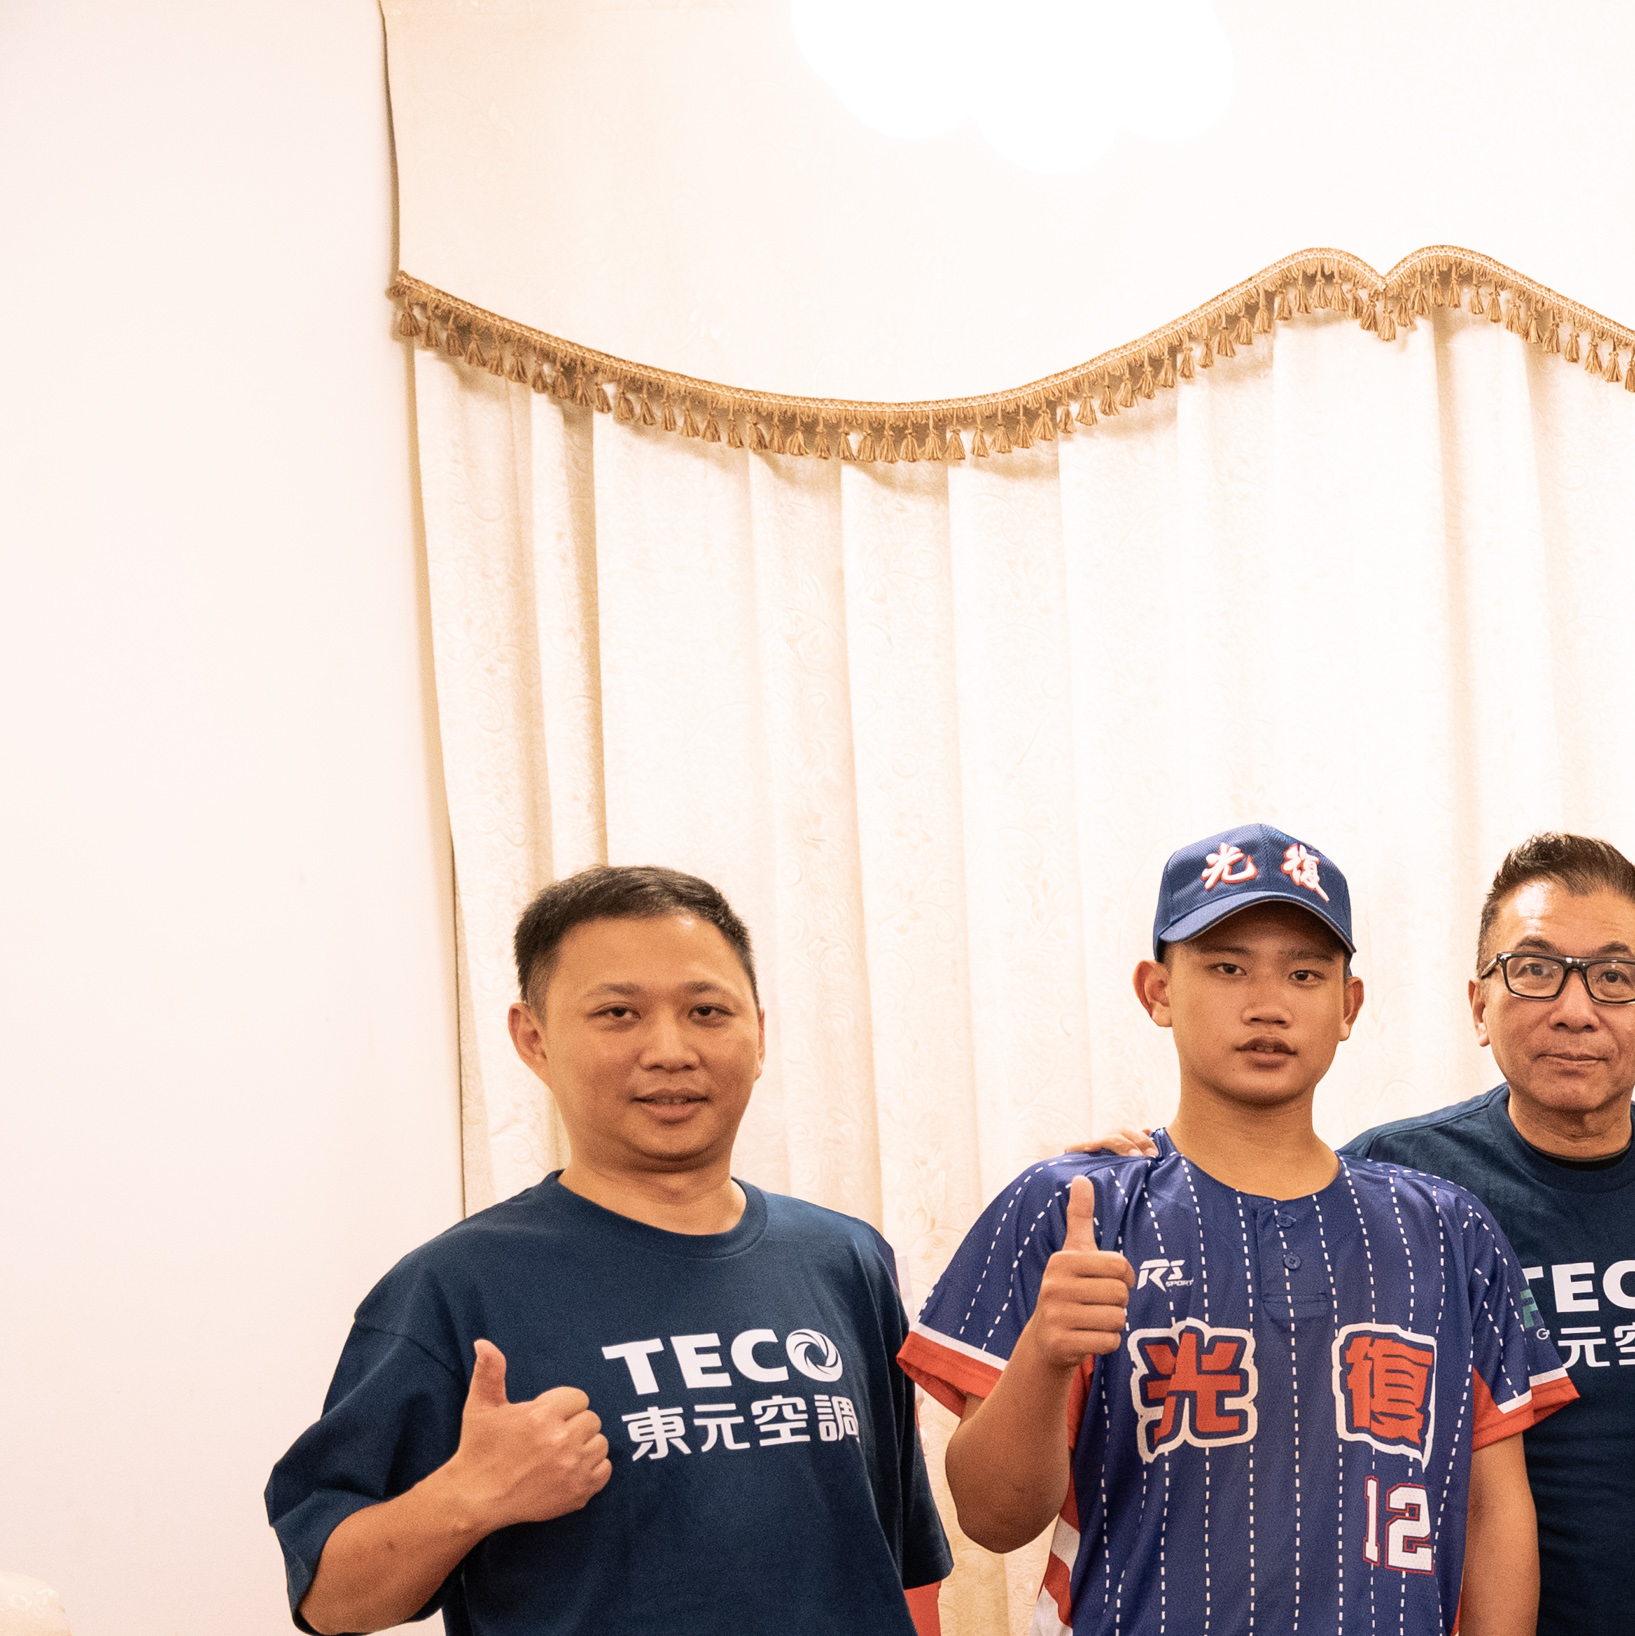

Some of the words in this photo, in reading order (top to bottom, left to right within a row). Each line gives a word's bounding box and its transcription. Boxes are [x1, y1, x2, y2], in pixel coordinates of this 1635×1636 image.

[1201, 842, 1330, 902] 光復
[601, 1328, 843, 1395] TECO
[1131, 1321, 1437, 1464] 光復
[621, 1394, 860, 1461] 東元空調
[1363, 1475, 1436, 1574] 12
